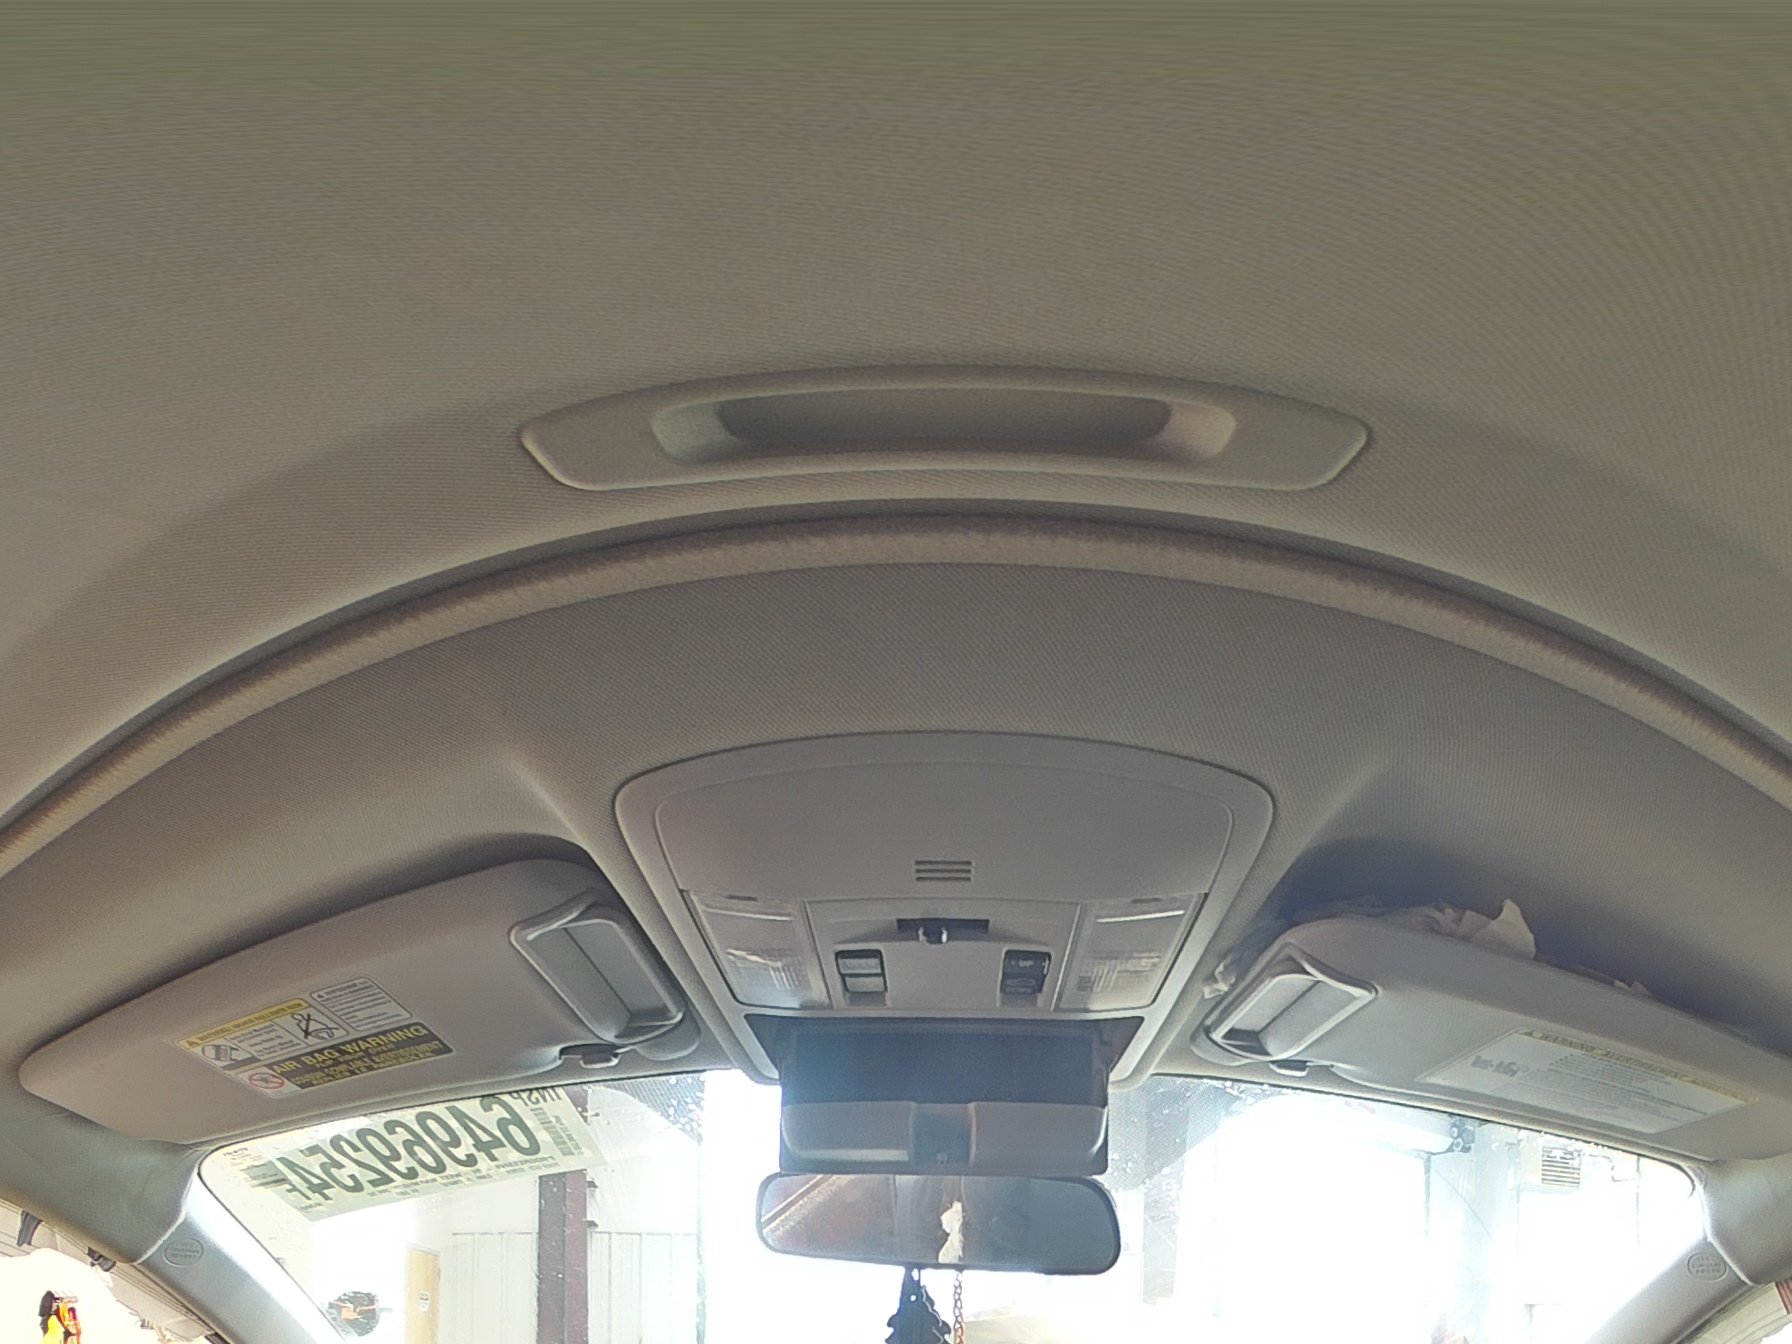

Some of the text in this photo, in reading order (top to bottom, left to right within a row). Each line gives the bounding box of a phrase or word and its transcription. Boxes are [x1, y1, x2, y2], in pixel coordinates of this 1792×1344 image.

[273, 1025, 429, 1074] AIR BAG WARNING
